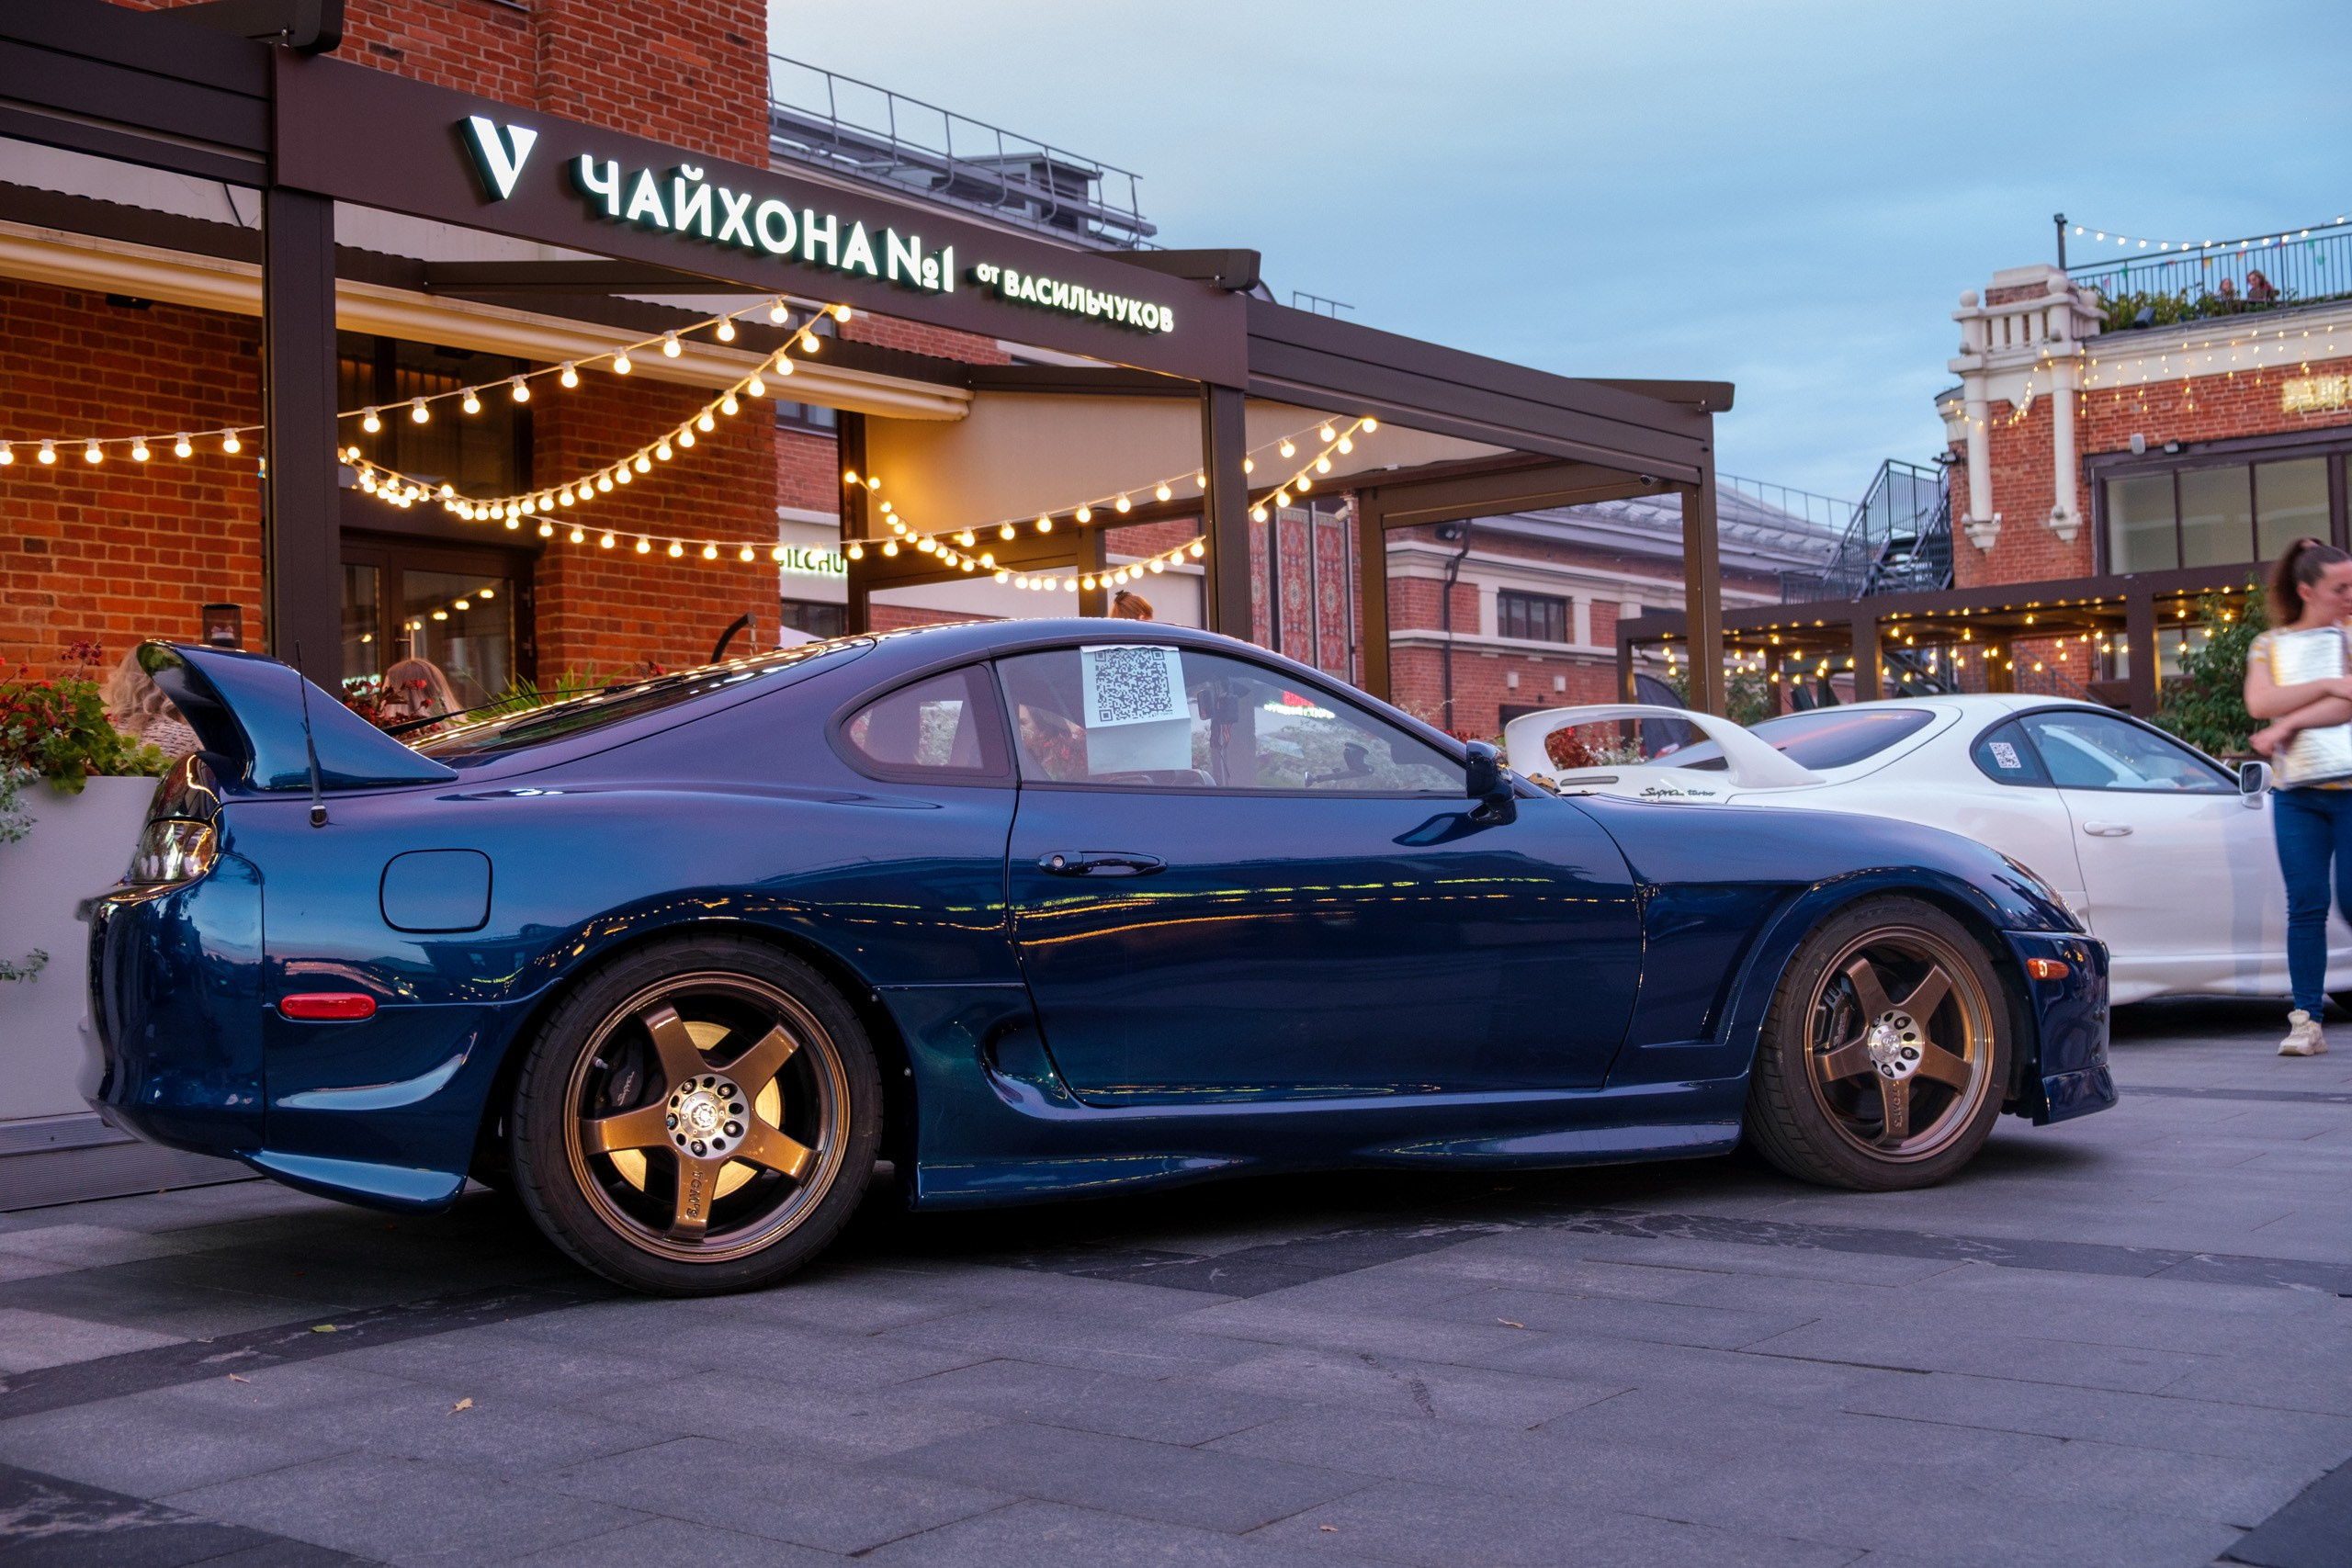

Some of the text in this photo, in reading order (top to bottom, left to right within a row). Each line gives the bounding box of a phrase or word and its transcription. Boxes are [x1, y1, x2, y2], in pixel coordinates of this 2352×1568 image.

[581, 153, 955, 293] ЧАЙХОНА №1
[1003, 269, 1174, 333] ВАСИЛЬЧУКОВ
[778, 548, 847, 574] ILCHU
